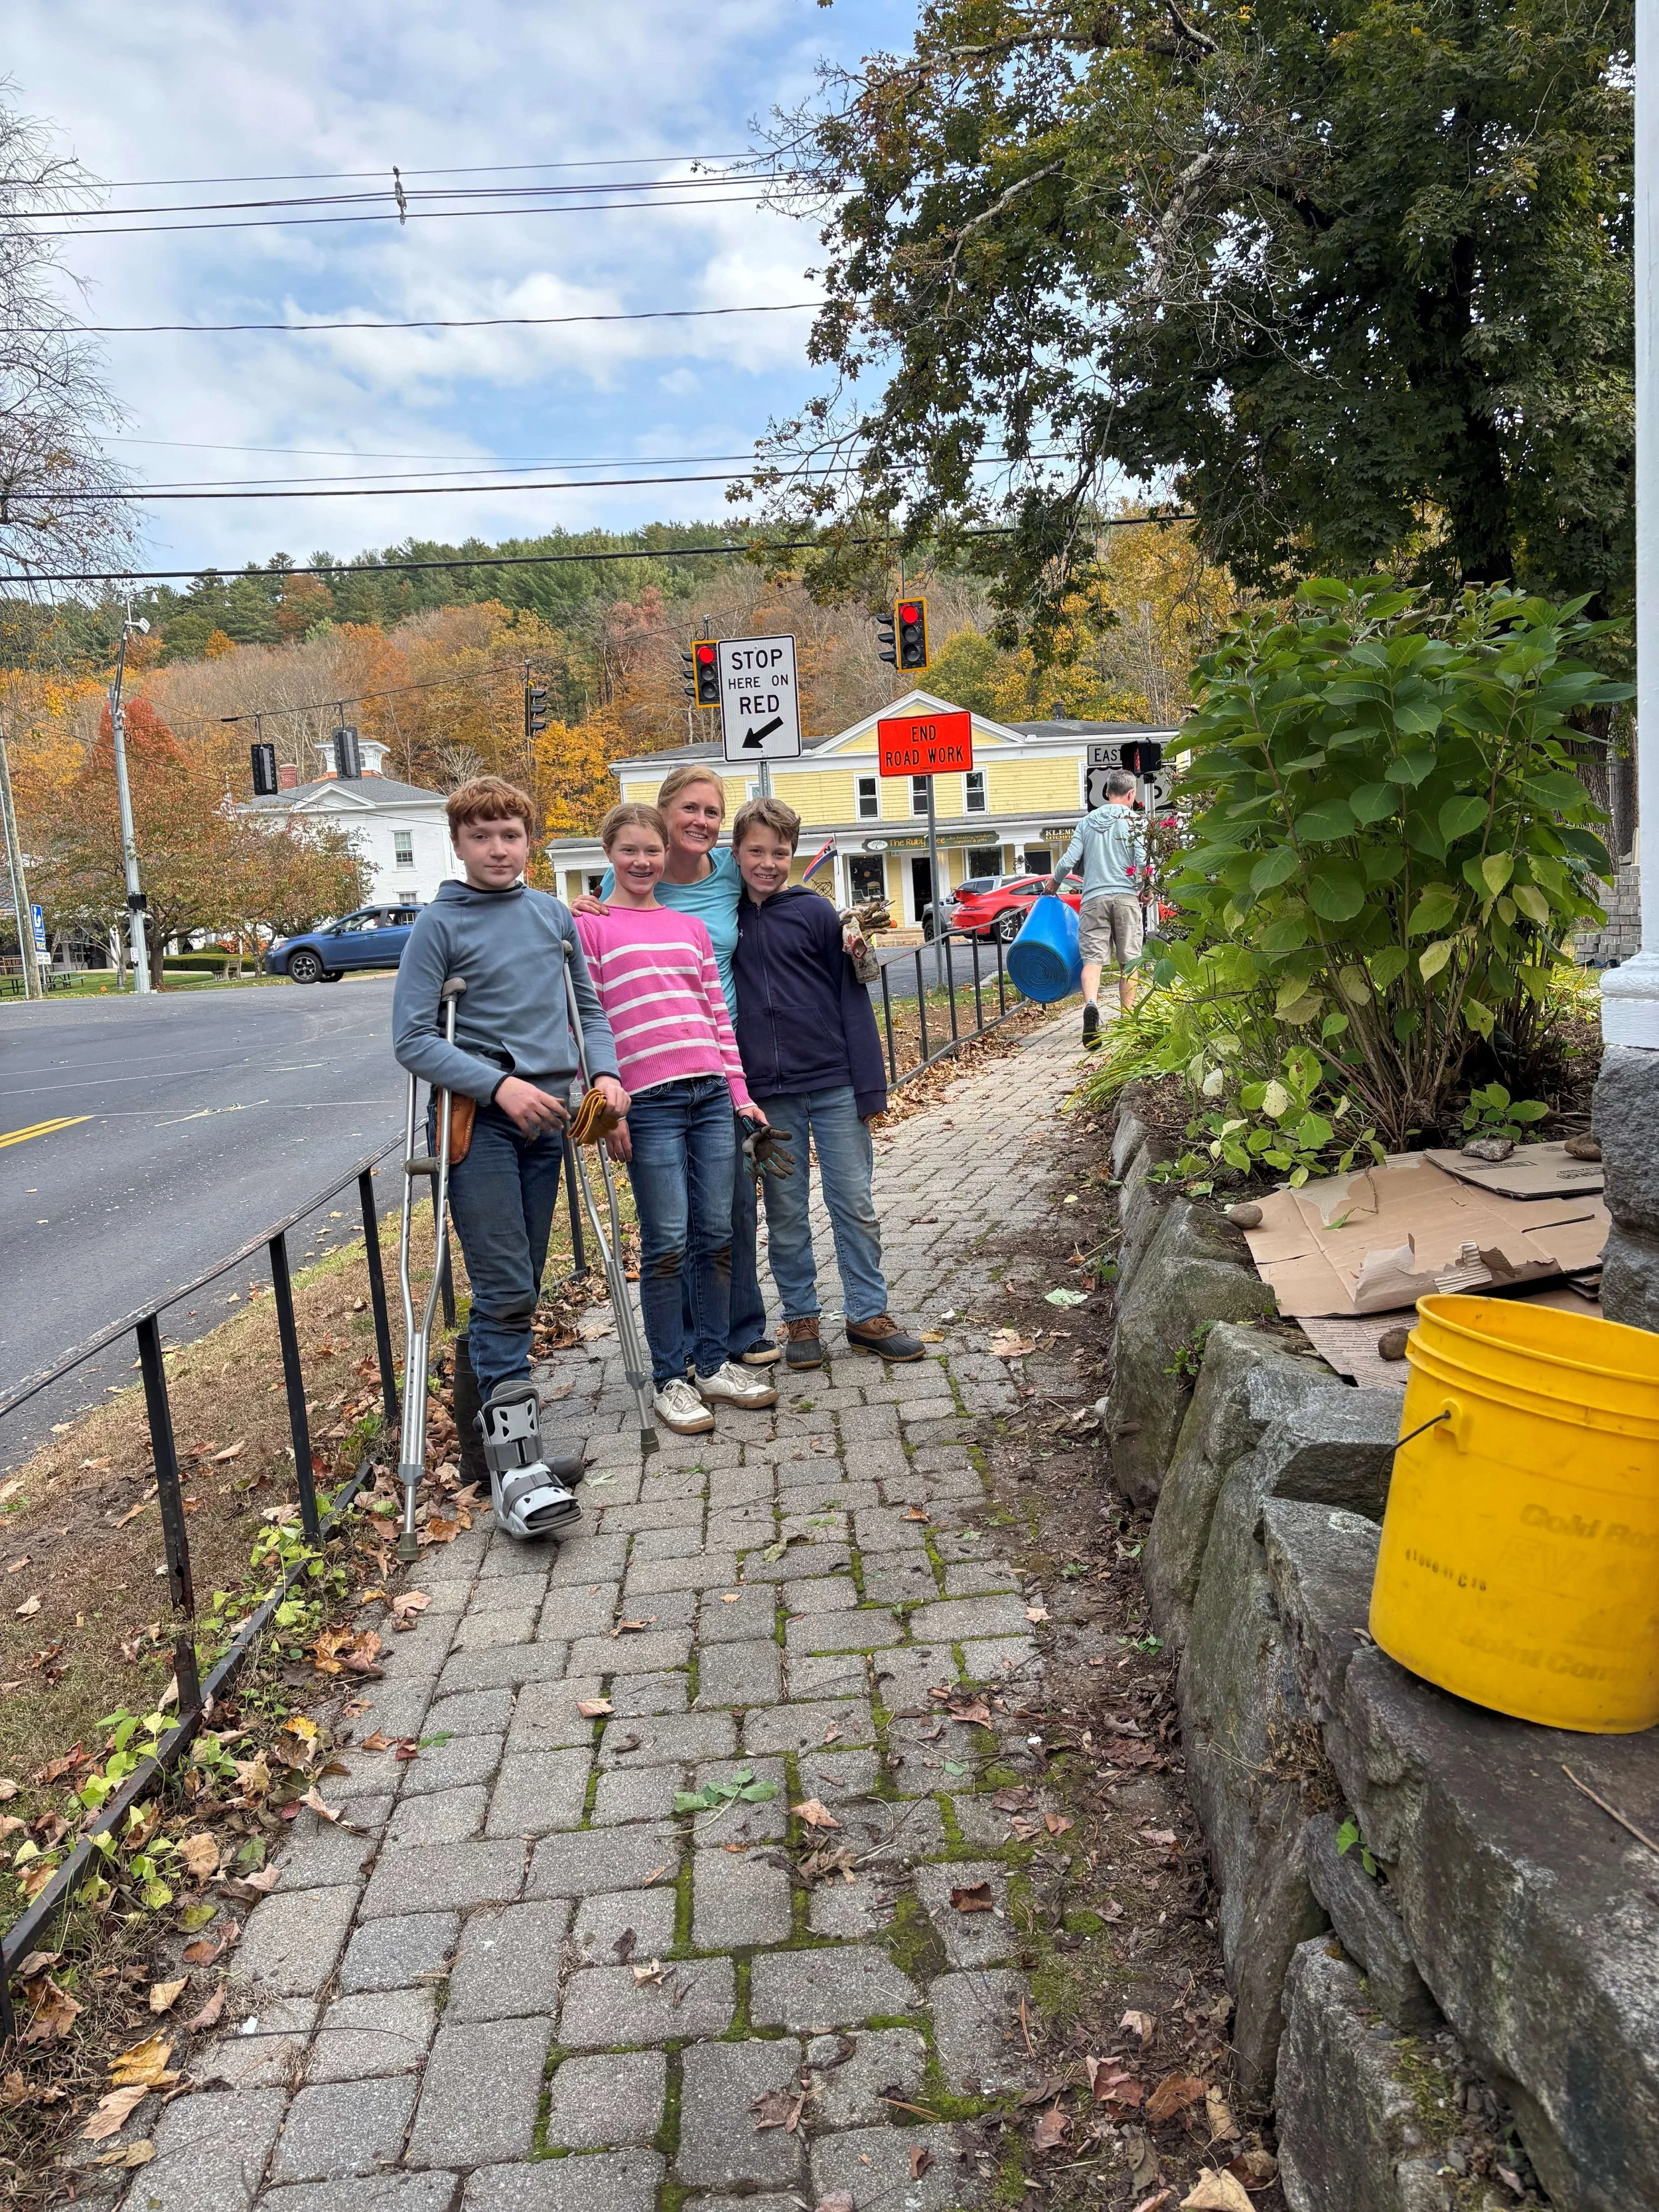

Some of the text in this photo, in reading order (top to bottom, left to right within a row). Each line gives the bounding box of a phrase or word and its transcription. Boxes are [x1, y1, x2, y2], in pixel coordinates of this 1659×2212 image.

[731, 648, 782, 670] STOP
[729, 674, 788, 690] HERE ON
[739, 694, 780, 715] RED
[911, 725, 936, 743] END
[886, 745, 964, 767] ROAD WORK
[1094, 748, 1122, 763] EAST
[906, 838, 926, 848] Ruby
[1520, 1503, 1601, 1539] Gold
